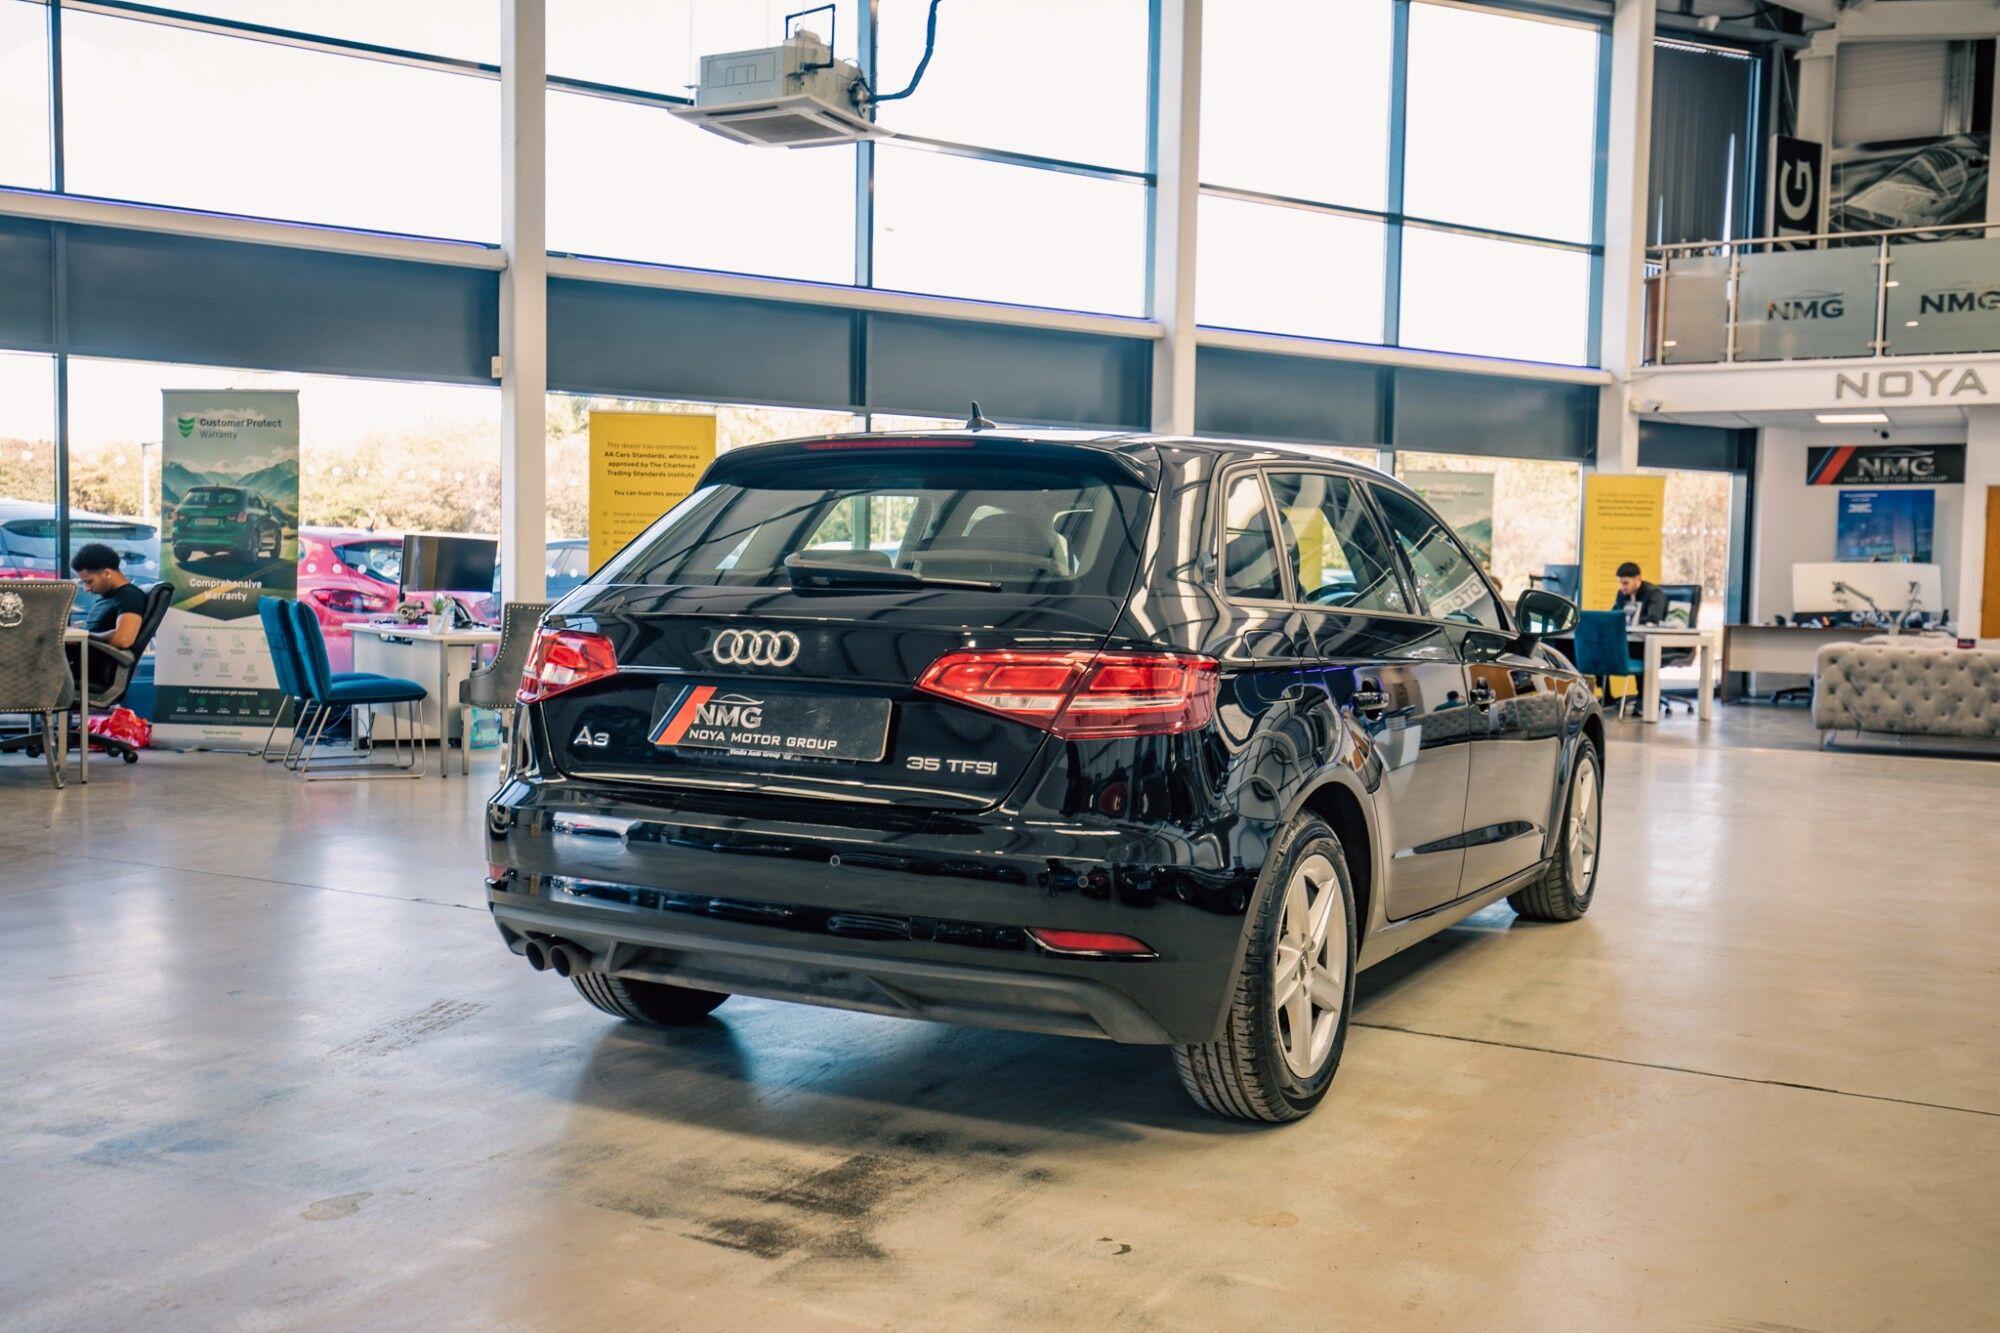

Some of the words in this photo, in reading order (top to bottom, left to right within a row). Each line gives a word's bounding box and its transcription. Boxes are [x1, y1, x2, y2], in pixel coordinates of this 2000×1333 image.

[1768, 299, 1844, 321] NMG
[1920, 291, 2000, 315] NMG
[1836, 369, 1988, 399] NOYA
[200, 418, 244, 428] Customer
[246, 419, 282, 428] Protect
[200, 430, 238, 440] Warranty
[1857, 456, 1936, 477] NMG
[1912, 475, 1948, 483] GROUP
[189, 578, 262, 589] Comprehensive
[204, 591, 247, 602] Warranty
[692, 703, 764, 729] NMG
[573, 725, 610, 747] A3
[689, 729, 725, 741] NOYA
[731, 732, 781, 746] MOTOR
[786, 737, 838, 750] GROUP
[906, 756, 940, 771] 35
[946, 759, 998, 775] TFSI
